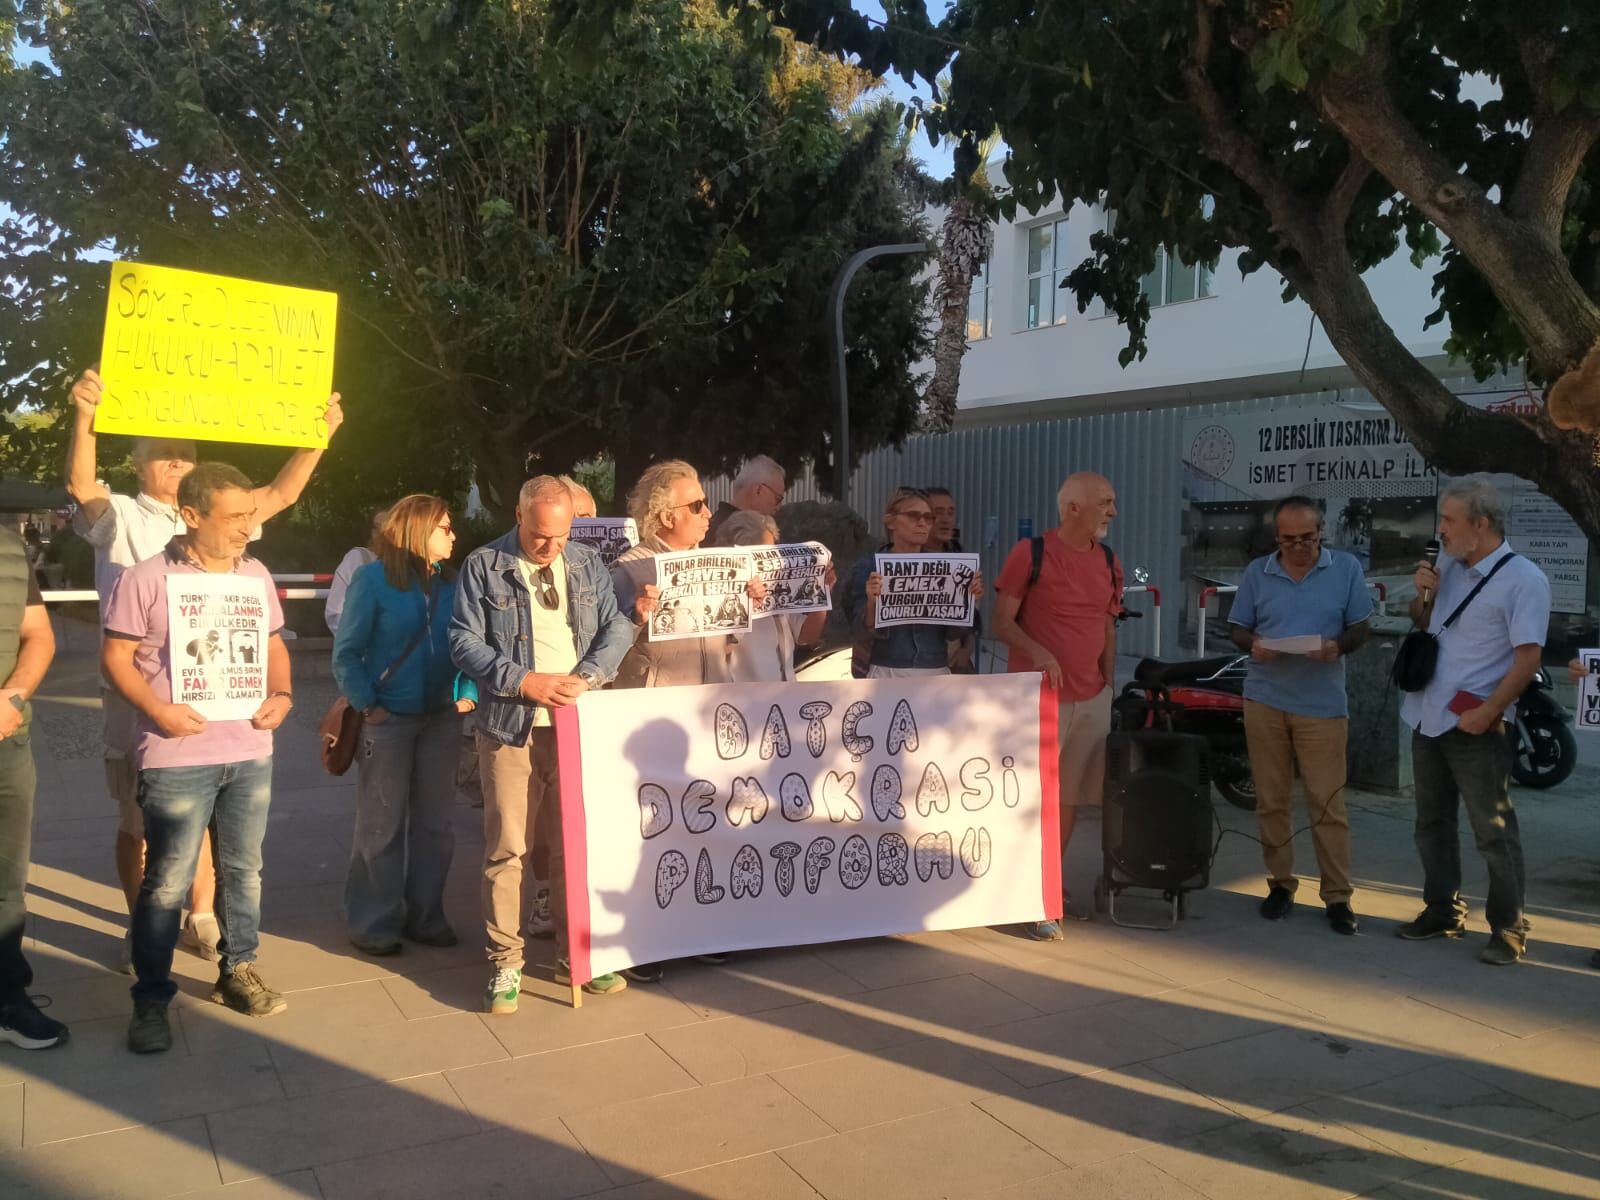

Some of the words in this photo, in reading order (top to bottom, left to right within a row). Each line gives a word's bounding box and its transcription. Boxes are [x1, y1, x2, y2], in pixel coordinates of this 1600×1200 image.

[1259, 427, 1272, 452] 12
[1275, 417, 1326, 451] DERSLİK
[1329, 418, 1390, 447] TASARIM
[1249, 462, 1297, 484] İSMET
[1306, 455, 1395, 482] TEKİNALP
[664, 559, 695, 576] FONLAR
[883, 561, 919, 576] RANT
[922, 560, 951, 576] DEĞİL
[881, 593, 925, 606] VURGUN
[882, 606, 924, 620] ONURLU
[926, 605, 965, 619] YAŞAM
[229, 676, 263, 689] DEMEK
[714, 698, 920, 762] DATÇA
[638, 756, 1019, 839] DEMOKRASİ
[655, 827, 992, 908] PLATFORMU
